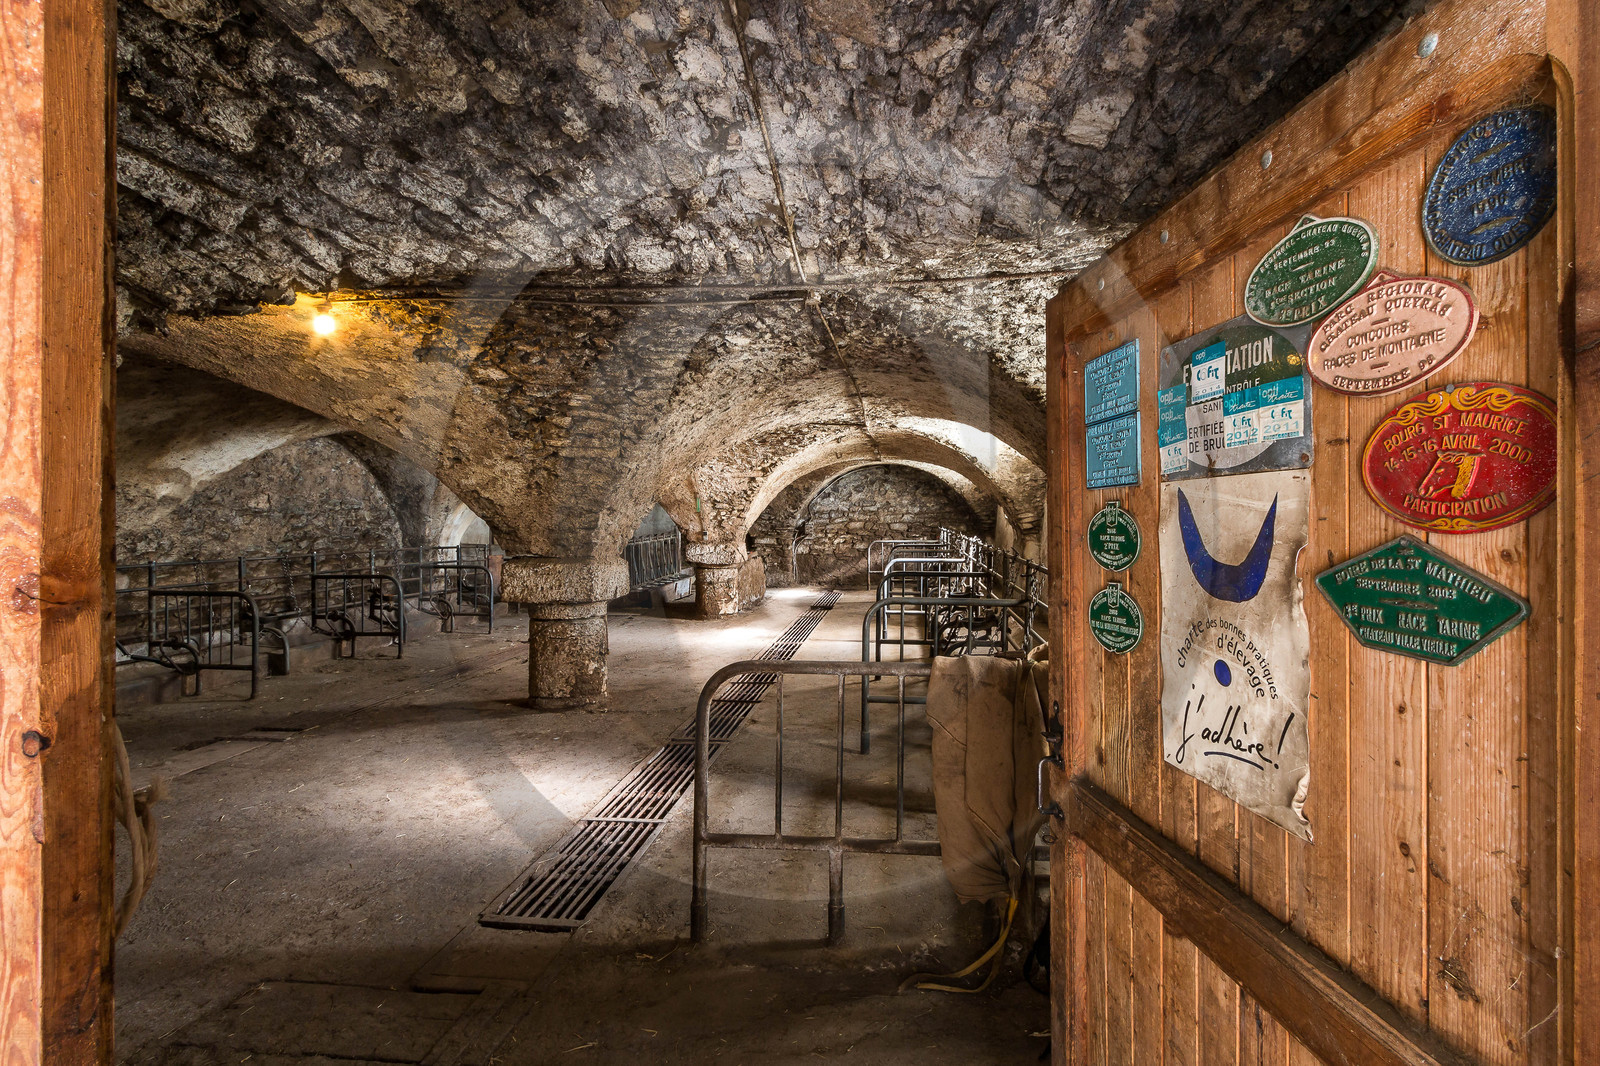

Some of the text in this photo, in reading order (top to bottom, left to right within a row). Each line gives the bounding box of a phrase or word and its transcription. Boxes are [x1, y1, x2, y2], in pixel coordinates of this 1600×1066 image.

[1273, 244, 1320, 271] SEPTEMBRE
[1265, 257, 1345, 299] RACE TARINE
[1293, 295, 1328, 321] PRIX
[1322, 282, 1447, 335] PARC REGIONAL
[1319, 296, 1452, 352] CHATEAU QUEYRAS
[1346, 319, 1410, 349] CONCOURS
[1323, 327, 1446, 373] RACES DE MONTAGNE
[1332, 367, 1411, 390] SEPTEMBRE
[1226, 428, 1258, 441] 2012
[1264, 420, 1299, 434] 2011
[1384, 412, 1529, 453] BOURG ST MAURICE
[1189, 440, 1199, 454] DE
[1442, 433, 1480, 450] AVRIL
[1488, 438, 1532, 465] 2000
[1404, 492, 1508, 516] PARTICIPATION
[1335, 557, 1494, 603] FOIRE DE LA ST MATHIEU
[1355, 577, 1457, 600] SEPTEMBRE 2003
[1360, 606, 1384, 625] PRIX
[1398, 612, 1427, 632] RACE
[1437, 617, 1480, 641] TARINE
[1360, 626, 1394, 645] CHATEAU
[1177, 620, 1205, 669] charte
[1206, 617, 1218, 630] des
[1219, 615, 1247, 643] bonnes
[1246, 641, 1279, 700] pratiques
[1217, 632, 1265, 698] d'élevage
